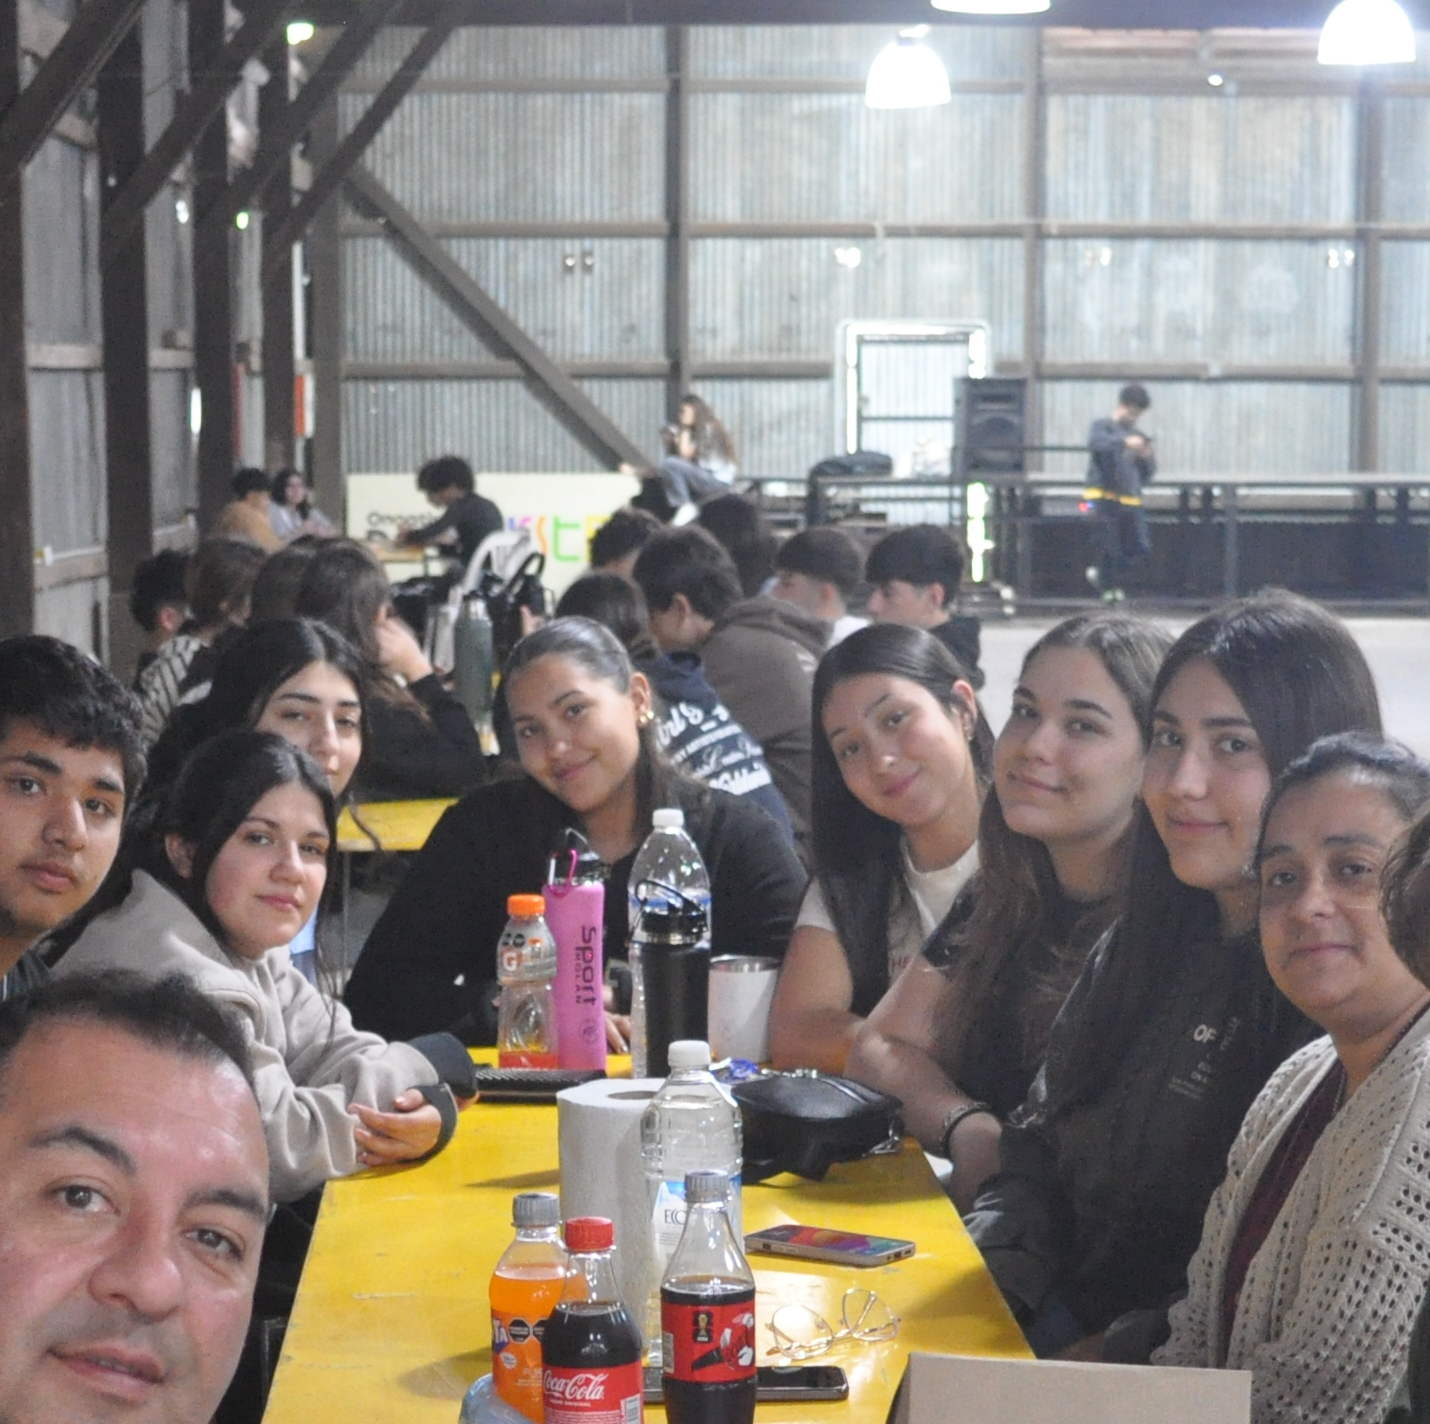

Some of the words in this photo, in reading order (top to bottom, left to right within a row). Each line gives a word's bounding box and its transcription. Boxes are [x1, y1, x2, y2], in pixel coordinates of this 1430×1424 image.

[575, 926, 597, 1006] Sport
[1193, 1024, 1217, 1043] OF
[543, 1369, 609, 1400] Coca-Cola
